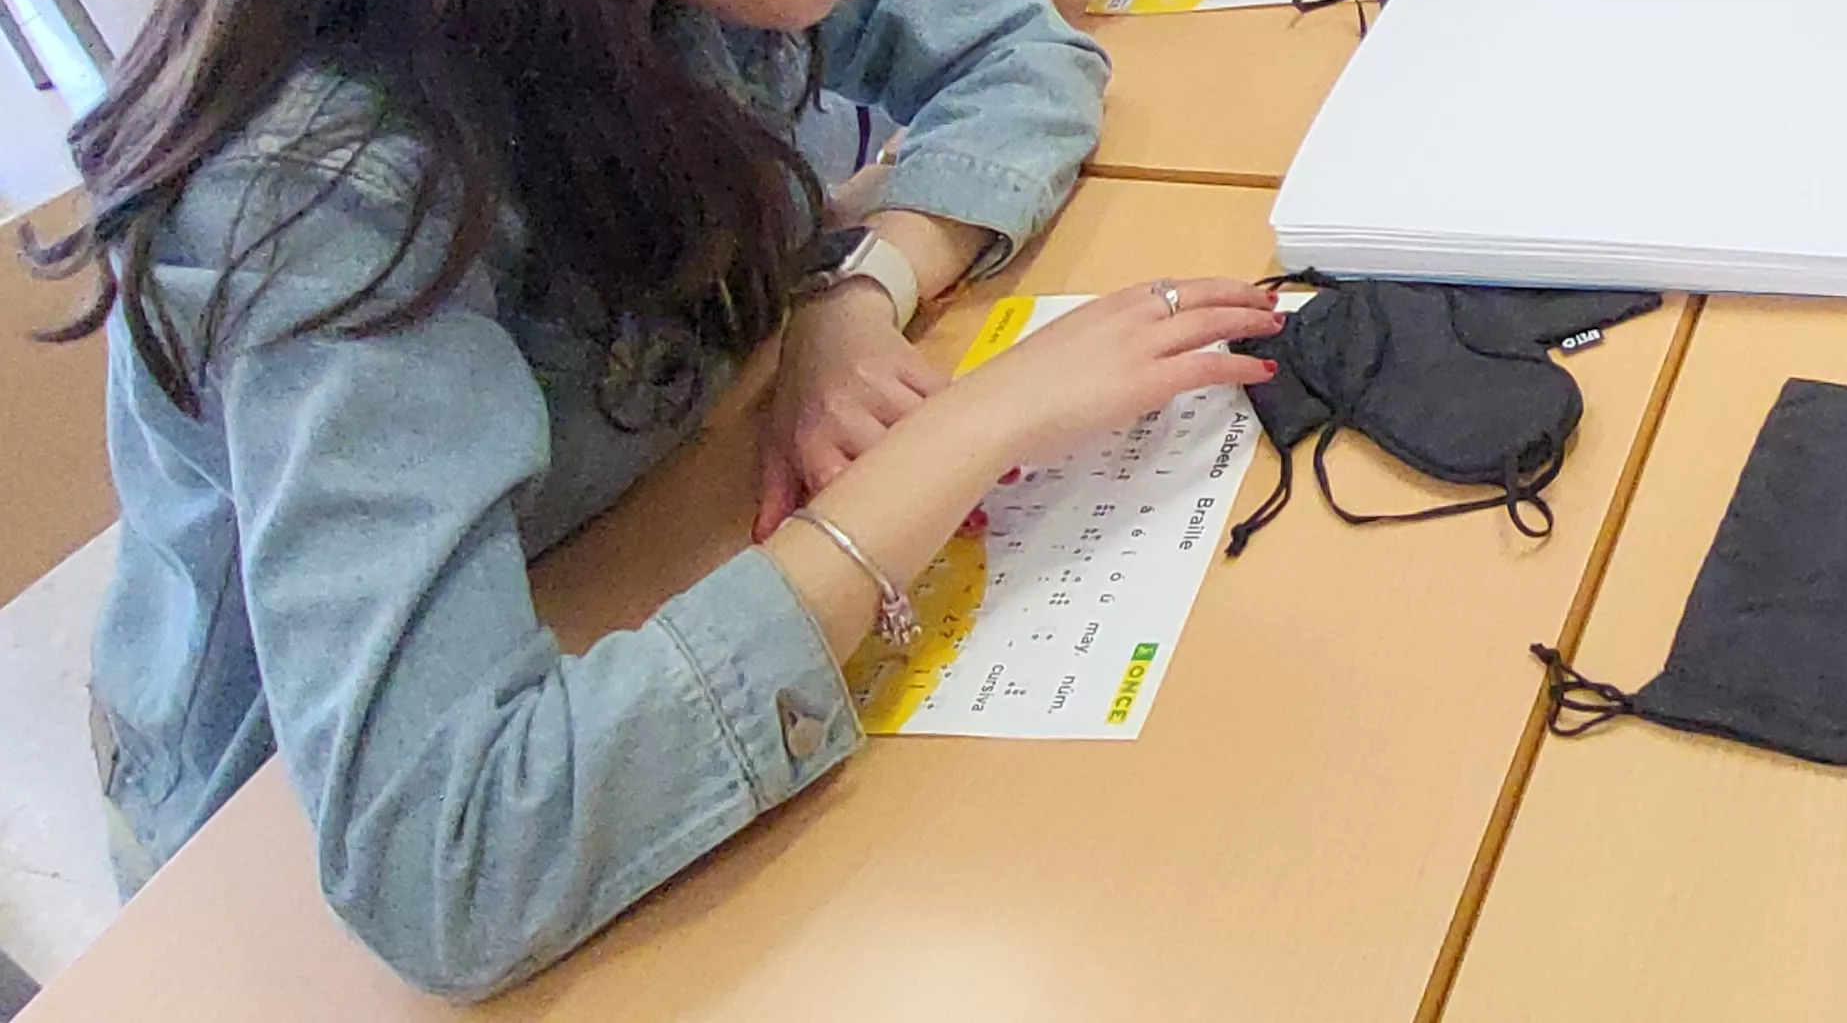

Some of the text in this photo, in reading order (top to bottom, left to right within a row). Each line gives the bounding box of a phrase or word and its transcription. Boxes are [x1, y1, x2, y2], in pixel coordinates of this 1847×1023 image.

[1178, 411, 1250, 551] Alfabeto Braille
[1099, 593, 1117, 605] ú
[1108, 571, 1126, 583] ó
[970, 663, 1006, 713] cursiva
[1046, 674, 1077, 715] núm.
[1106, 663, 1147, 723] ONCE
